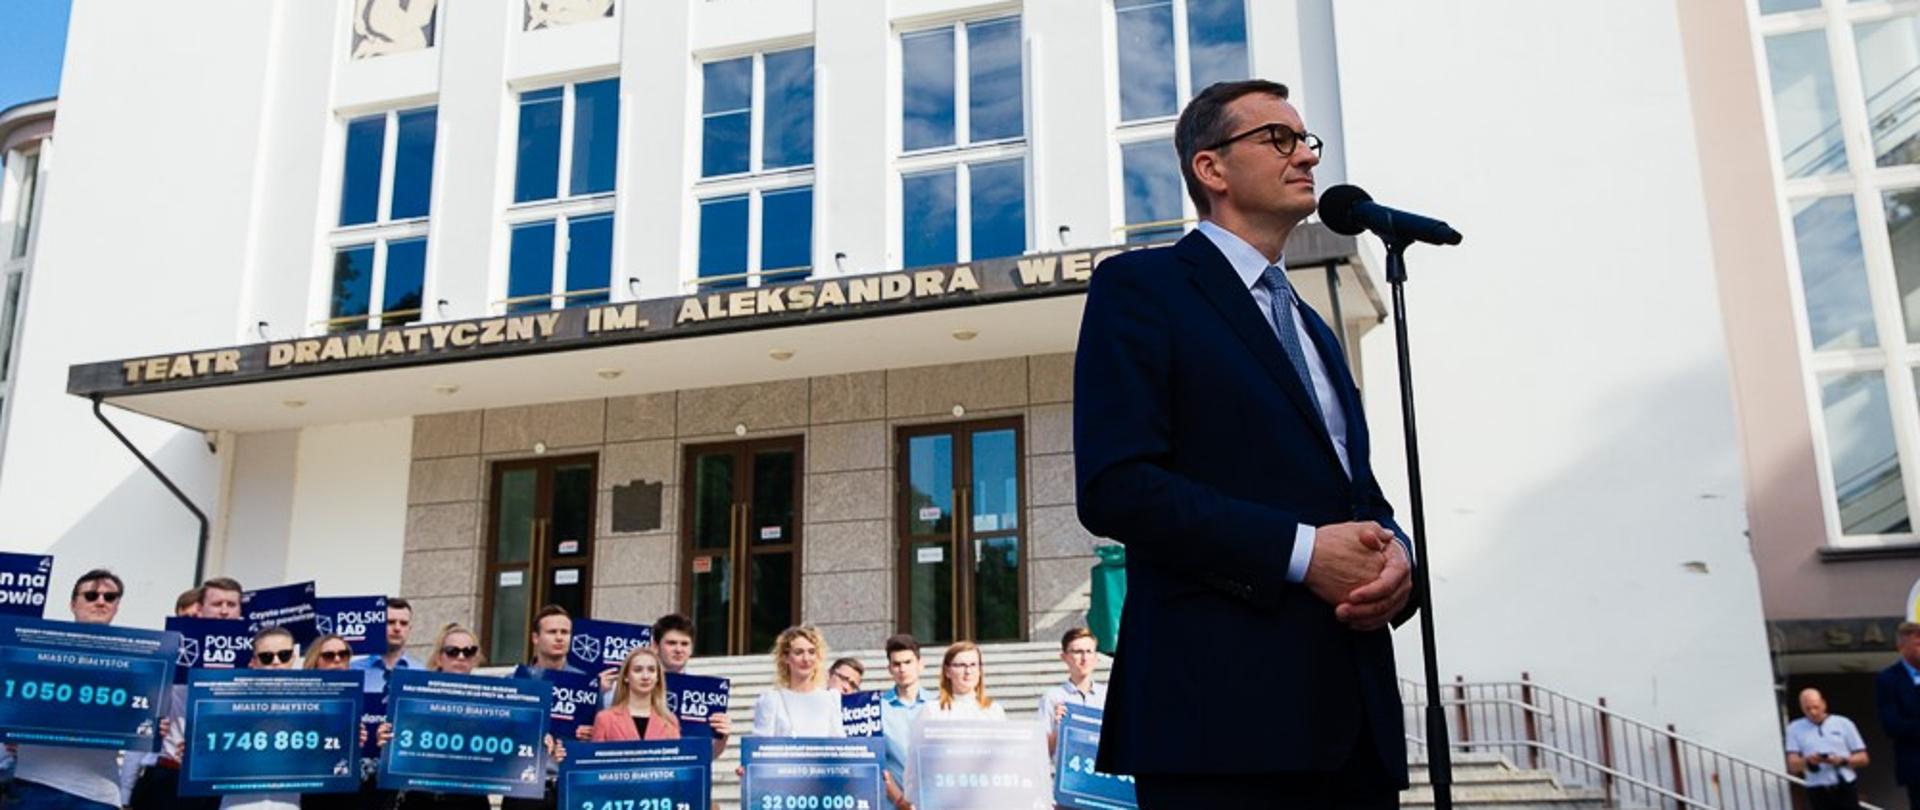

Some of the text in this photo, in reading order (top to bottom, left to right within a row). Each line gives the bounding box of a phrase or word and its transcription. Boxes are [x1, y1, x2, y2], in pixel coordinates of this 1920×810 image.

[122, 350, 239, 381] TEATR
[267, 312, 562, 367] DRAMATYCZNY
[587, 303, 648, 331] IM.
[675, 264, 981, 324] ALEKSANDRA
[17, 573, 46, 588] na
[337, 612, 386, 624] POLSKI
[336, 623, 366, 636] ŁAD
[204, 635, 254, 650] POLSK
[38, 653, 129, 669] MIASTO BIAŁYSTOK
[203, 649, 236, 662] ŁAD
[5, 680, 15, 698] 1
[22, 681, 72, 701] 050
[80, 686, 127, 706] 950
[682, 690, 728, 706] POLSKI
[232, 703, 320, 712] MIASTO BIAŁYSTOK
[430, 703, 511, 717] MIASTO BIAŁYSTOK
[681, 703, 709, 716] ŁAD
[207, 732, 217, 751] 1
[222, 731, 268, 751] 746
[273, 731, 320, 750] 869
[400, 730, 413, 748] 3
[420, 731, 464, 751] 800
[469, 735, 513, 755] 000
[598, 770, 675, 780] MIASTO BIAŁYSTOK
[762, 795, 782, 809] 32
[786, 795, 819, 809] 000
[823, 795, 855, 809] 000
